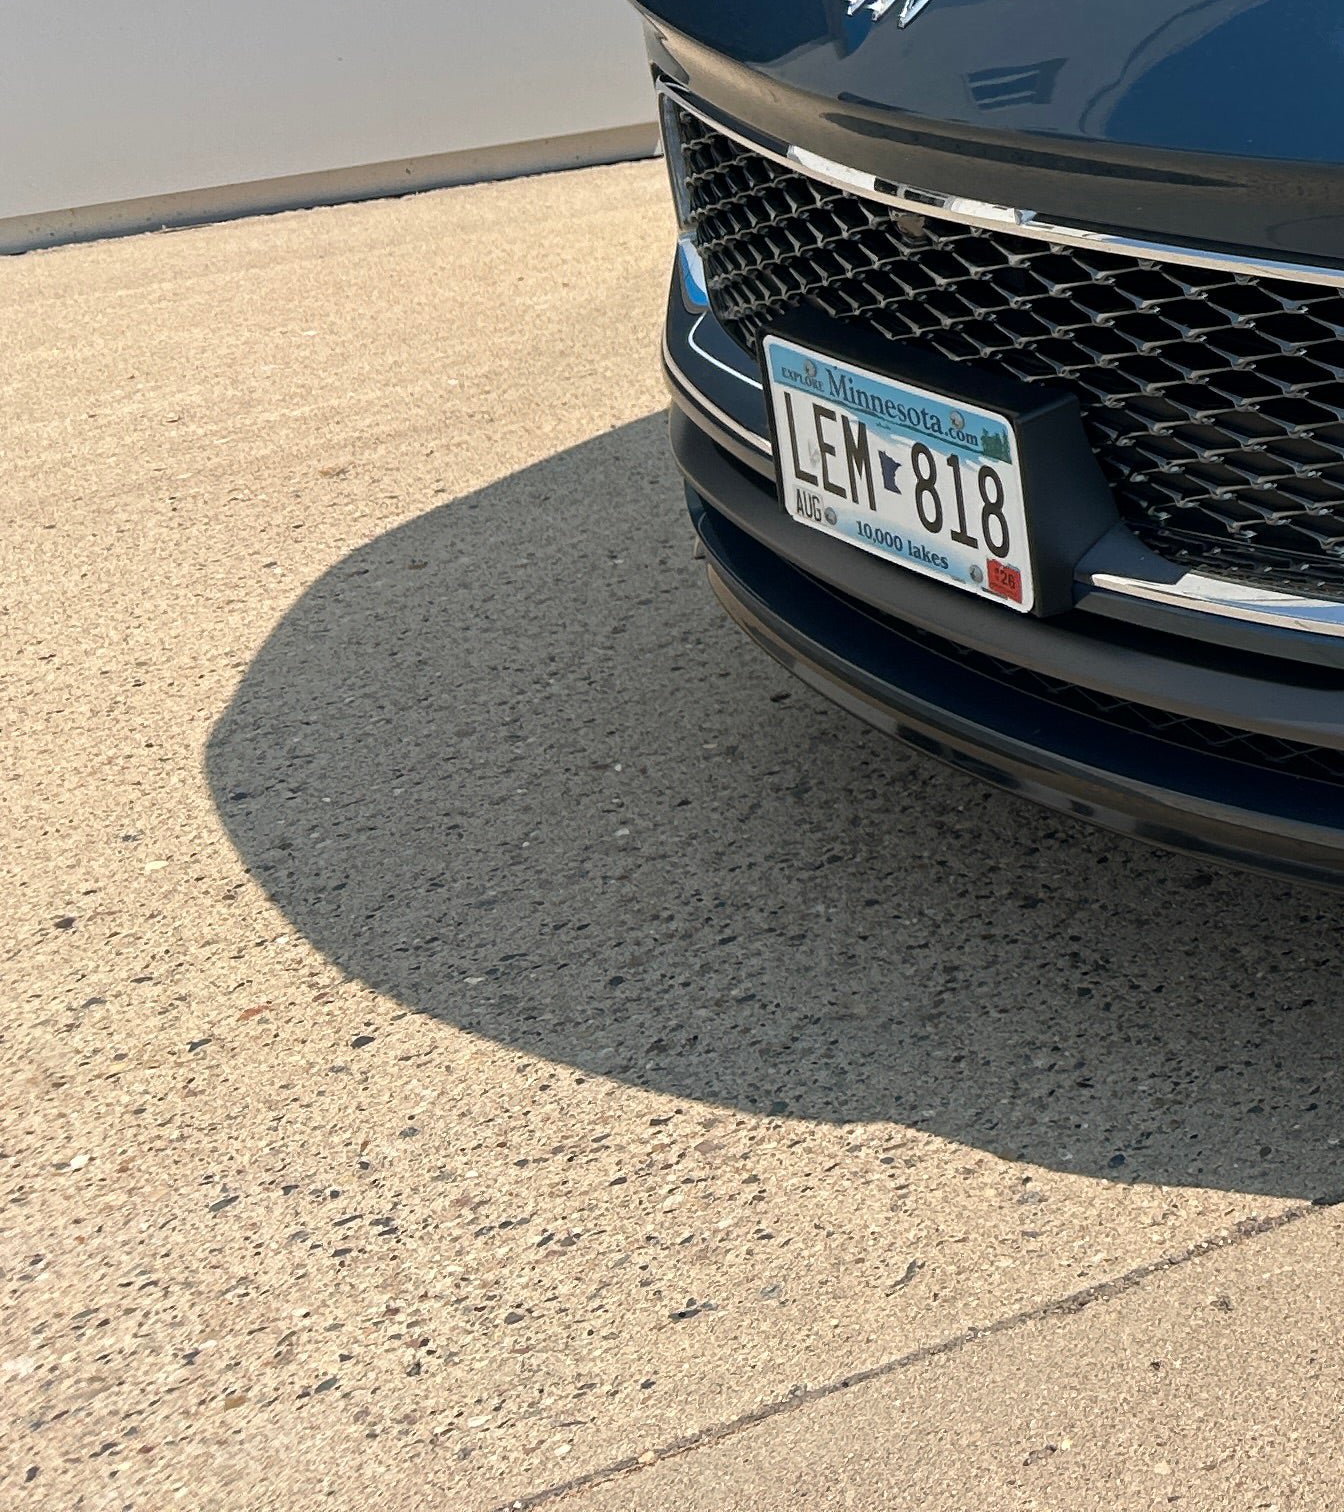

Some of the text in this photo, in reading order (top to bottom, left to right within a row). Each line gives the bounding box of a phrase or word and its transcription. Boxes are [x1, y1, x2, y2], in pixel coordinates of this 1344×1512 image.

[783, 390, 1010, 559] LEM 818
[796, 489, 823, 522] AUG
[856, 519, 950, 571] 10,000 lakes
